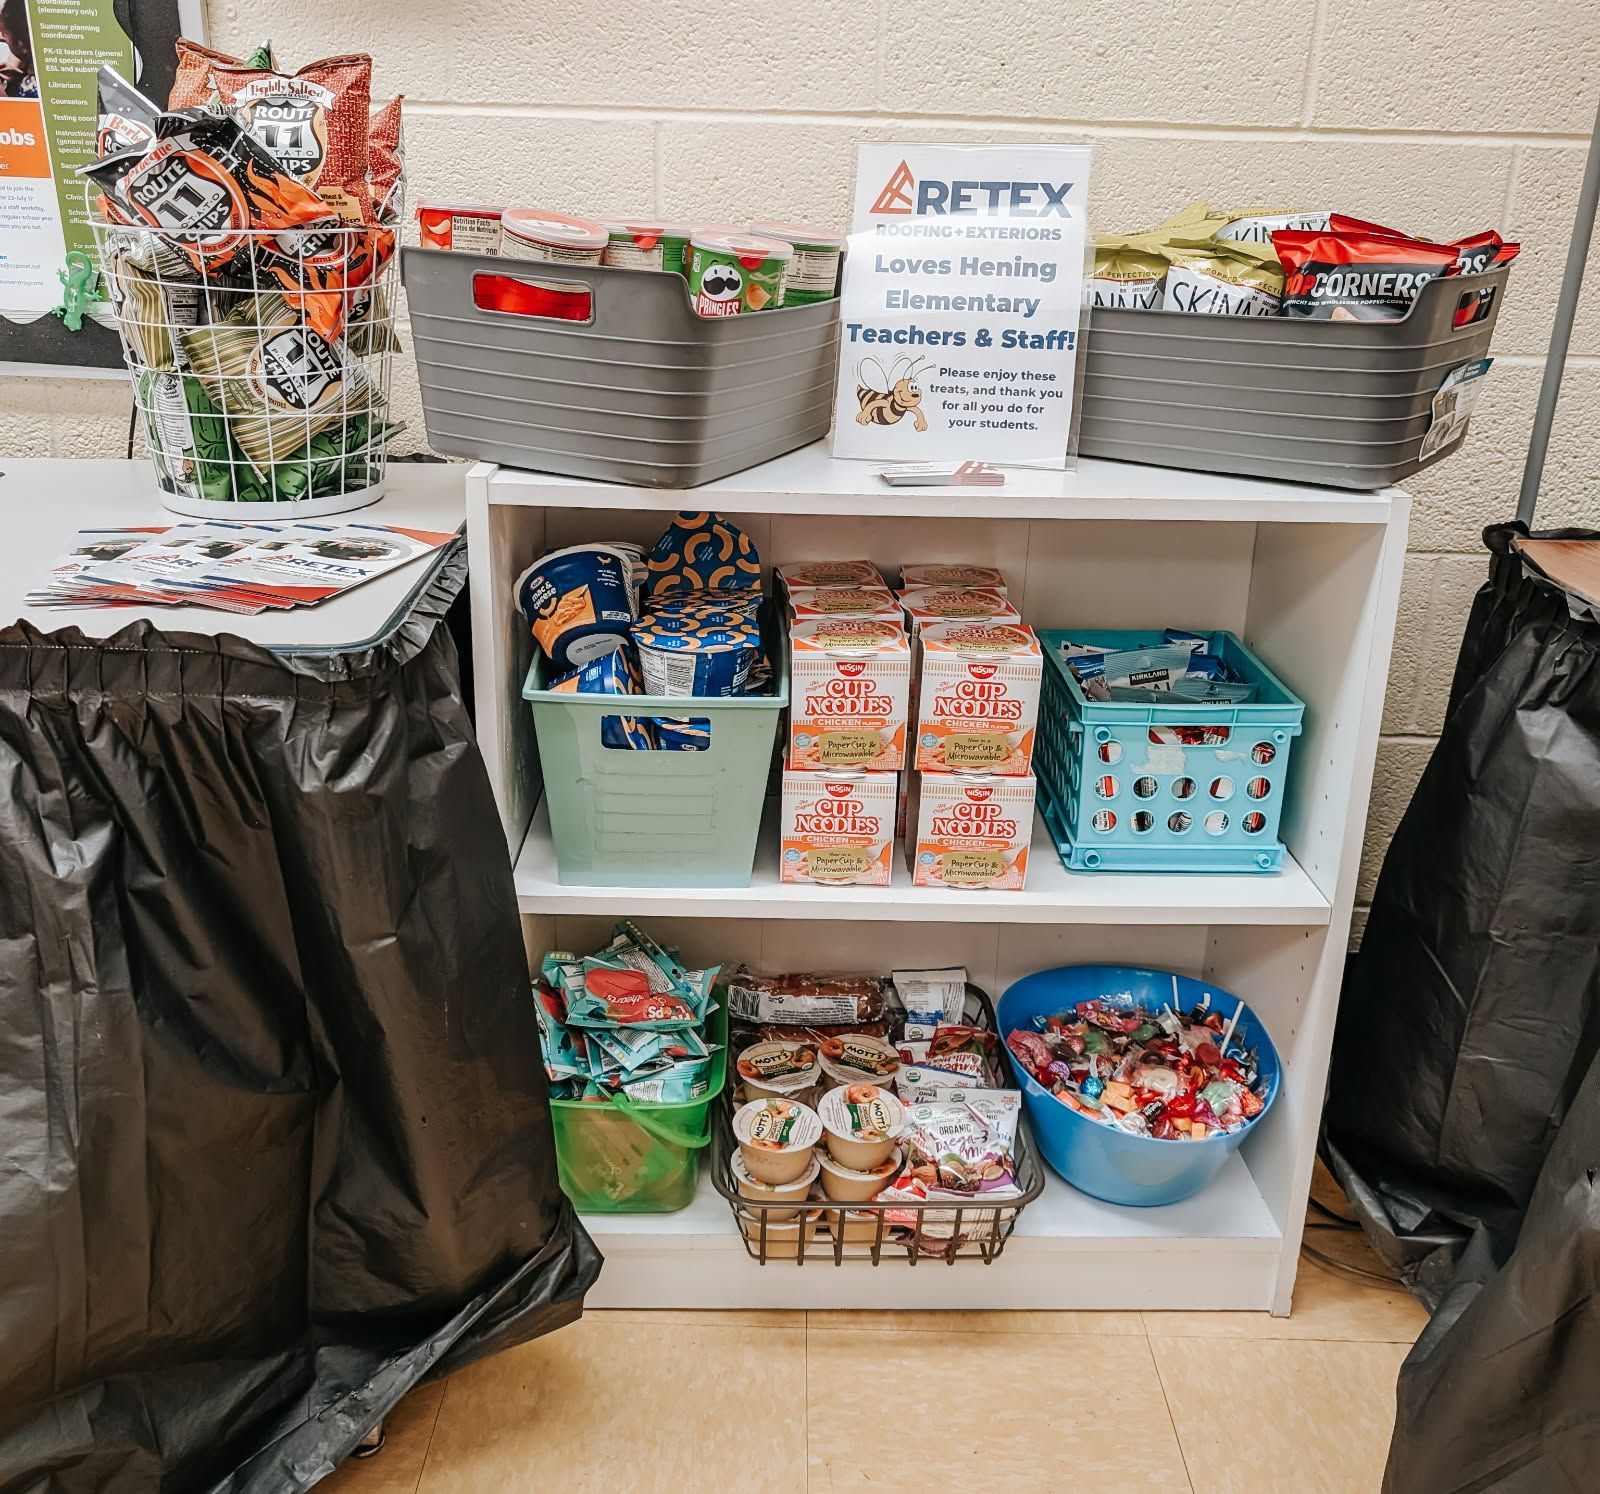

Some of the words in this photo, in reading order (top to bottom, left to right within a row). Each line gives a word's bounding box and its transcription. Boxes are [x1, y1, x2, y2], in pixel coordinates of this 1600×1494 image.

[38, 6, 80, 16] (elementary
[81, 8, 98, 16] only)
[70, 24, 100, 32] planning
[250, 80, 287, 97] Lightly
[287, 81, 324, 97] Salted
[53, 114, 76, 122] Testing
[254, 105, 316, 120] ROUTE
[258, 124, 304, 149] 11
[133, 159, 187, 205] ROUTE
[156, 181, 206, 223] 11
[916, 180, 1075, 219] RETEX
[454, 216, 476, 225] Nutrition
[874, 254, 952, 275] Loves
[960, 255, 1058, 283] Hening
[1206, 266, 1238, 282] POPPED
[700, 294, 739, 316] PRINGLES
[886, 289, 1041, 318] Elementary
[846, 323, 967, 347] Teachers
[974, 328, 993, 348] &
[1001, 329, 1076, 351] Staff!
[264, 355, 300, 404] CHIPS
[939, 367, 980, 379] Please
[983, 369, 1018, 382] enjoy
[1020, 370, 1057, 382] these
[930, 384, 969, 396] treats,
[972, 385, 996, 396] and
[1000, 386, 1036, 398] thank
[1040, 388, 1063, 400] you
[942, 400, 960, 412] for
[962, 401, 978, 412] all
[980, 403, 1004, 414] you
[1007, 402, 1024, 414] do
[1026, 403, 1045, 415] for
[948, 418, 977, 429] your
[979, 419, 1038, 431] students.
[287, 558, 374, 576] RETEX
[532, 586, 546, 602] mac
[533, 587, 557, 610] cheese
[839, 663, 863, 672] NISSIN
[970, 666, 995, 674] NISSIN
[1130, 670, 1168, 682] KIRKLAND
[826, 679, 876, 697] CUP
[956, 680, 1007, 700] CUP
[805, 696, 892, 716] NOODLES
[933, 696, 1022, 720] NOODLES
[946, 720, 989, 728] CHICKEN
[852, 741, 866, 749] Cup
[954, 743, 977, 752] Paper
[978, 744, 994, 753] Cup
[822, 750, 875, 759] Microwavable
[967, 789, 990, 797] NISSIN
[815, 799, 863, 817] CUP
[953, 802, 1002, 820] CUP
[794, 814, 879, 835] NOODLES
[931, 817, 1016, 838] NOODLES
[943, 839, 985, 847] CHICKEN
[811, 865, 862, 873] Microwavable
[817, 857, 838, 865] Paper
[839, 857, 854, 866] Cup
[951, 860, 972, 868] Paper
[974, 861, 989, 869] Cup
[944, 868, 996, 877] Microwavable
[754, 1052, 789, 1066] MOTT'S
[846, 1046, 886, 1060] MOTT'S
[873, 1102, 886, 1130] MOTT'S
[754, 1113, 770, 1138] MOTT'S
[939, 1124, 972, 1136] ORGANIC
